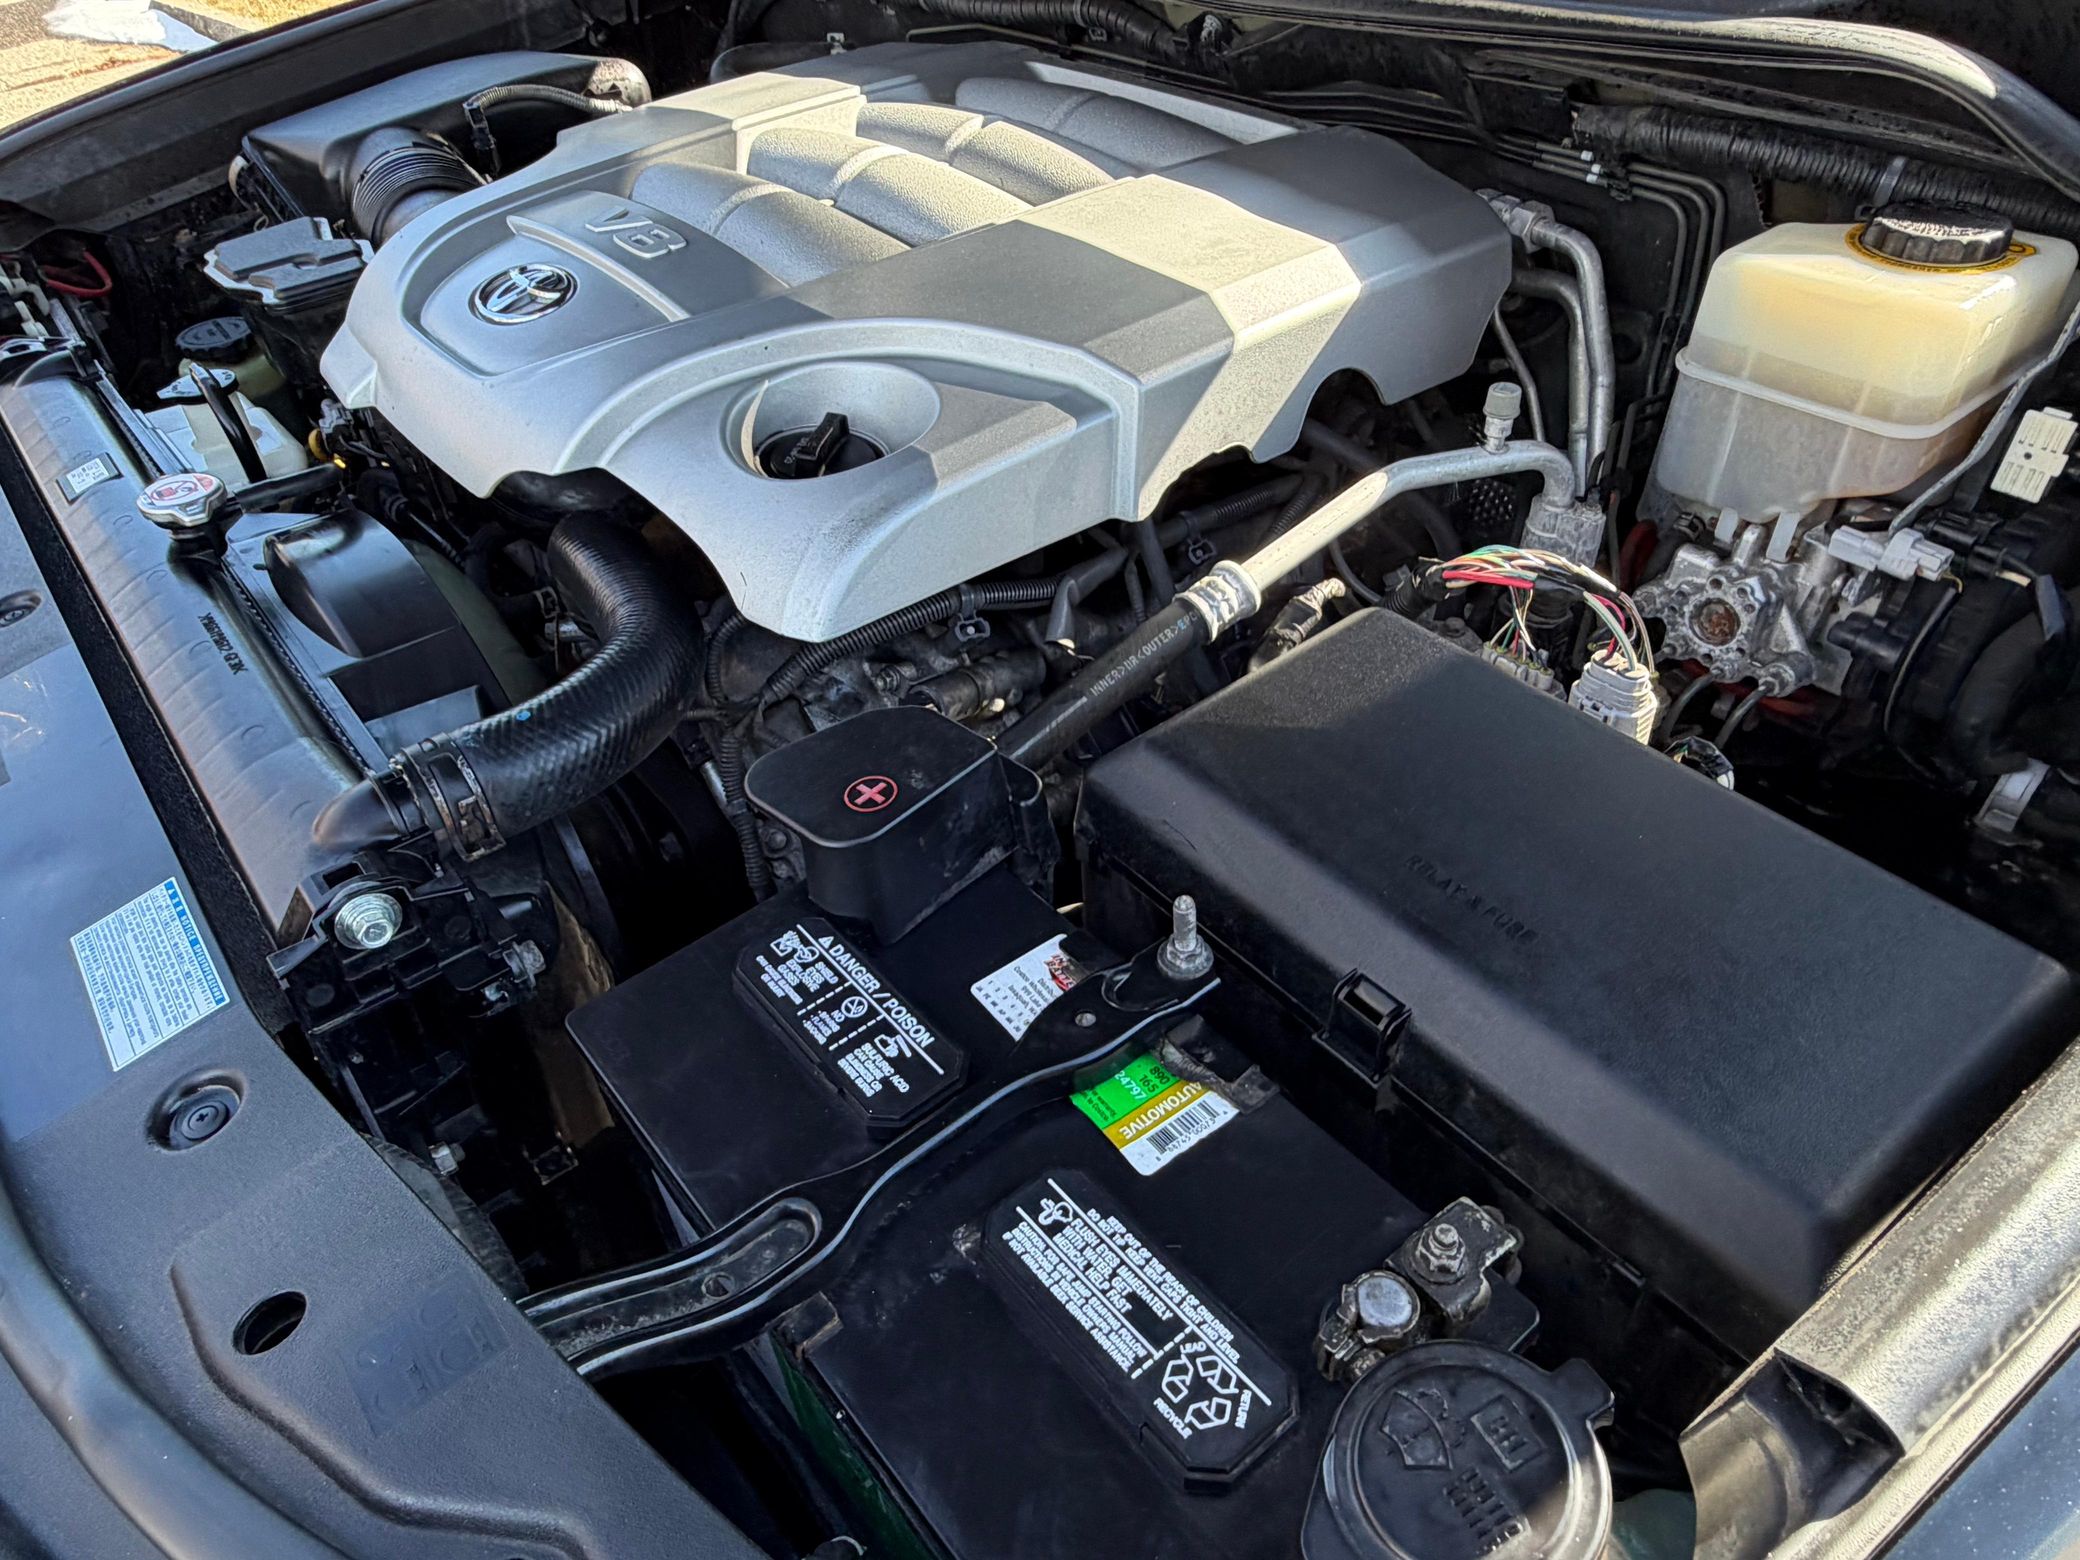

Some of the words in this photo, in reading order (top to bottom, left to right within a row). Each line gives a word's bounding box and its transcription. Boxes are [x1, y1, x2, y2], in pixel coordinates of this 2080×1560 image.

[584, 205, 688, 259] V8
[778, 964, 800, 986] GASES
[786, 959, 819, 992] EXPLOSIVE
[829, 944, 880, 993] DANGER
[883, 998, 934, 1048] POISON
[831, 1010, 845, 1022] NO
[861, 1043, 894, 1076] SULFURIC
[890, 1075, 909, 1092] ACID
[1114, 1071, 1147, 1100] 24797
[1139, 1074, 1159, 1093] 165
[1149, 1065, 1171, 1085] 890
[1119, 1081, 1202, 1140] AUTOMOTIVE
[1062, 1225, 1086, 1250] WITH
[1111, 1274, 1135, 1296] GET
[1124, 1233, 1141, 1249] OUT
[1138, 1248, 1152, 1260] OF
[1052, 1233, 1088, 1271] MEDICAL
[1085, 1265, 1113, 1293] HELP
[1106, 1286, 1132, 1313] FAST
[1071, 1218, 1100, 1247] FLUSH
[1096, 1243, 1120, 1269] EYES
[1116, 1265, 1173, 1320] IMMEDIATELY
[1087, 1208, 1101, 1222] DO
[1097, 1219, 1115, 1235] NOT
[1160, 1281, 1182, 1304] CAPS
[1200, 1321, 1222, 1343] AND
[1180, 1340, 1206, 1355] LEAD
[1153, 1397, 1194, 1439] RECYCLE
[1234, 1389, 1252, 1430] RETURN
